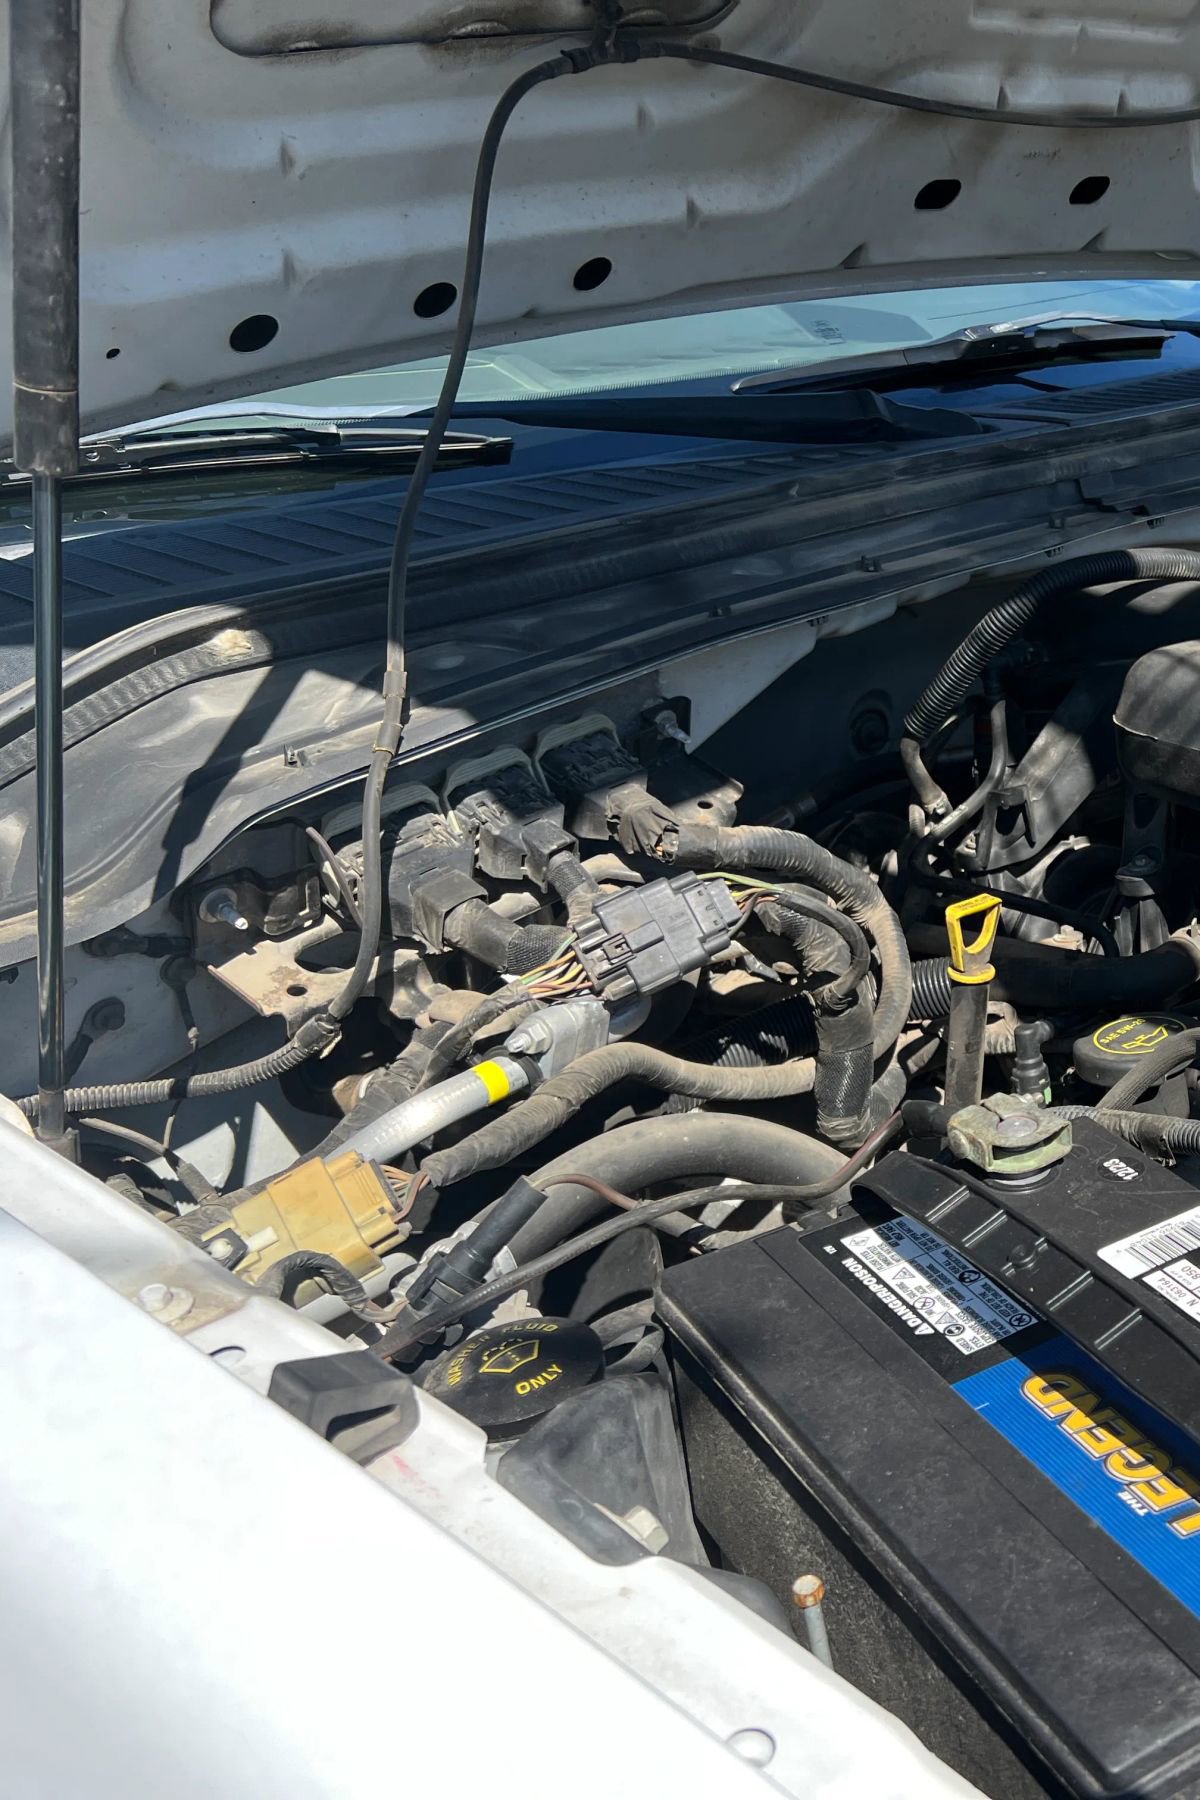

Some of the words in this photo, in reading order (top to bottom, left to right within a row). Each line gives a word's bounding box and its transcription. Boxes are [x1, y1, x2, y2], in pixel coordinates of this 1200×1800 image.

[1099, 1033, 1119, 1044] SAE
[1102, 1158, 1139, 1180] 12/23
[839, 1256, 924, 1327] DANGER/POISON
[1155, 1276, 1188, 1298] 063164
[1184, 1298, 1199, 1307] N
[447, 1335, 491, 1386] WASHER
[502, 1322, 560, 1333] FLUID
[515, 1363, 563, 1396] ONLY
[1116, 1491, 1149, 1517] THE
